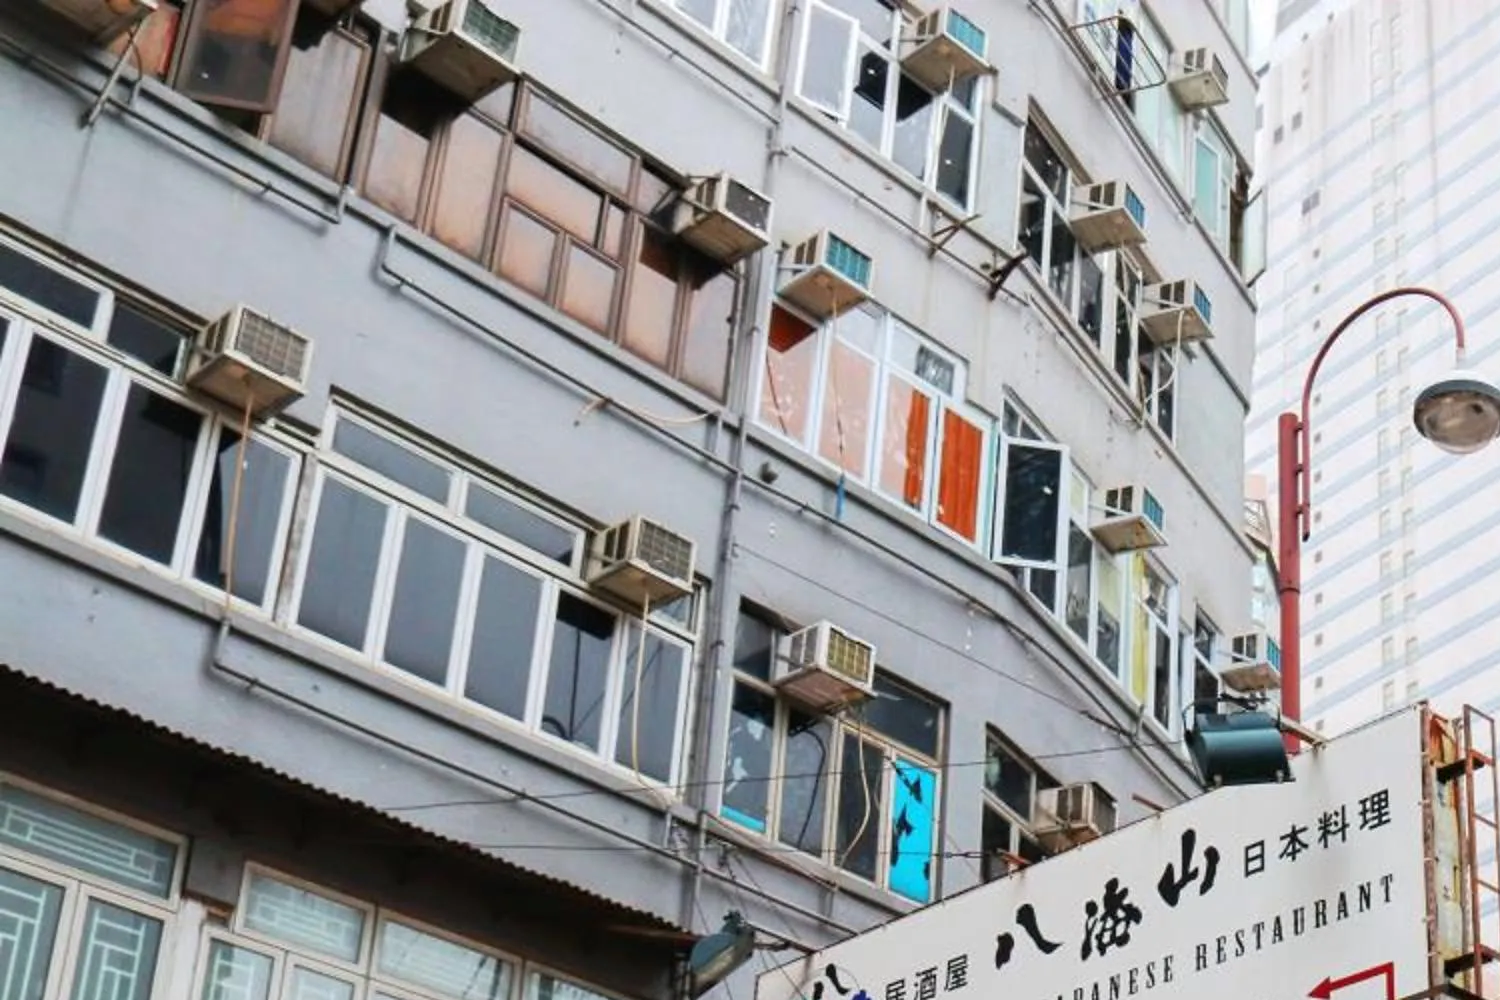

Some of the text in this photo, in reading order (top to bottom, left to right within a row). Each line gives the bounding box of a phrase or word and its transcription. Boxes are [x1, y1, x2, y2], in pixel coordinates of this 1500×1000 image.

[1244, 788, 1391, 878] 日本料理
[995, 828, 1221, 970] 八海山
[1195, 874, 1395, 972] RESTAURANT
